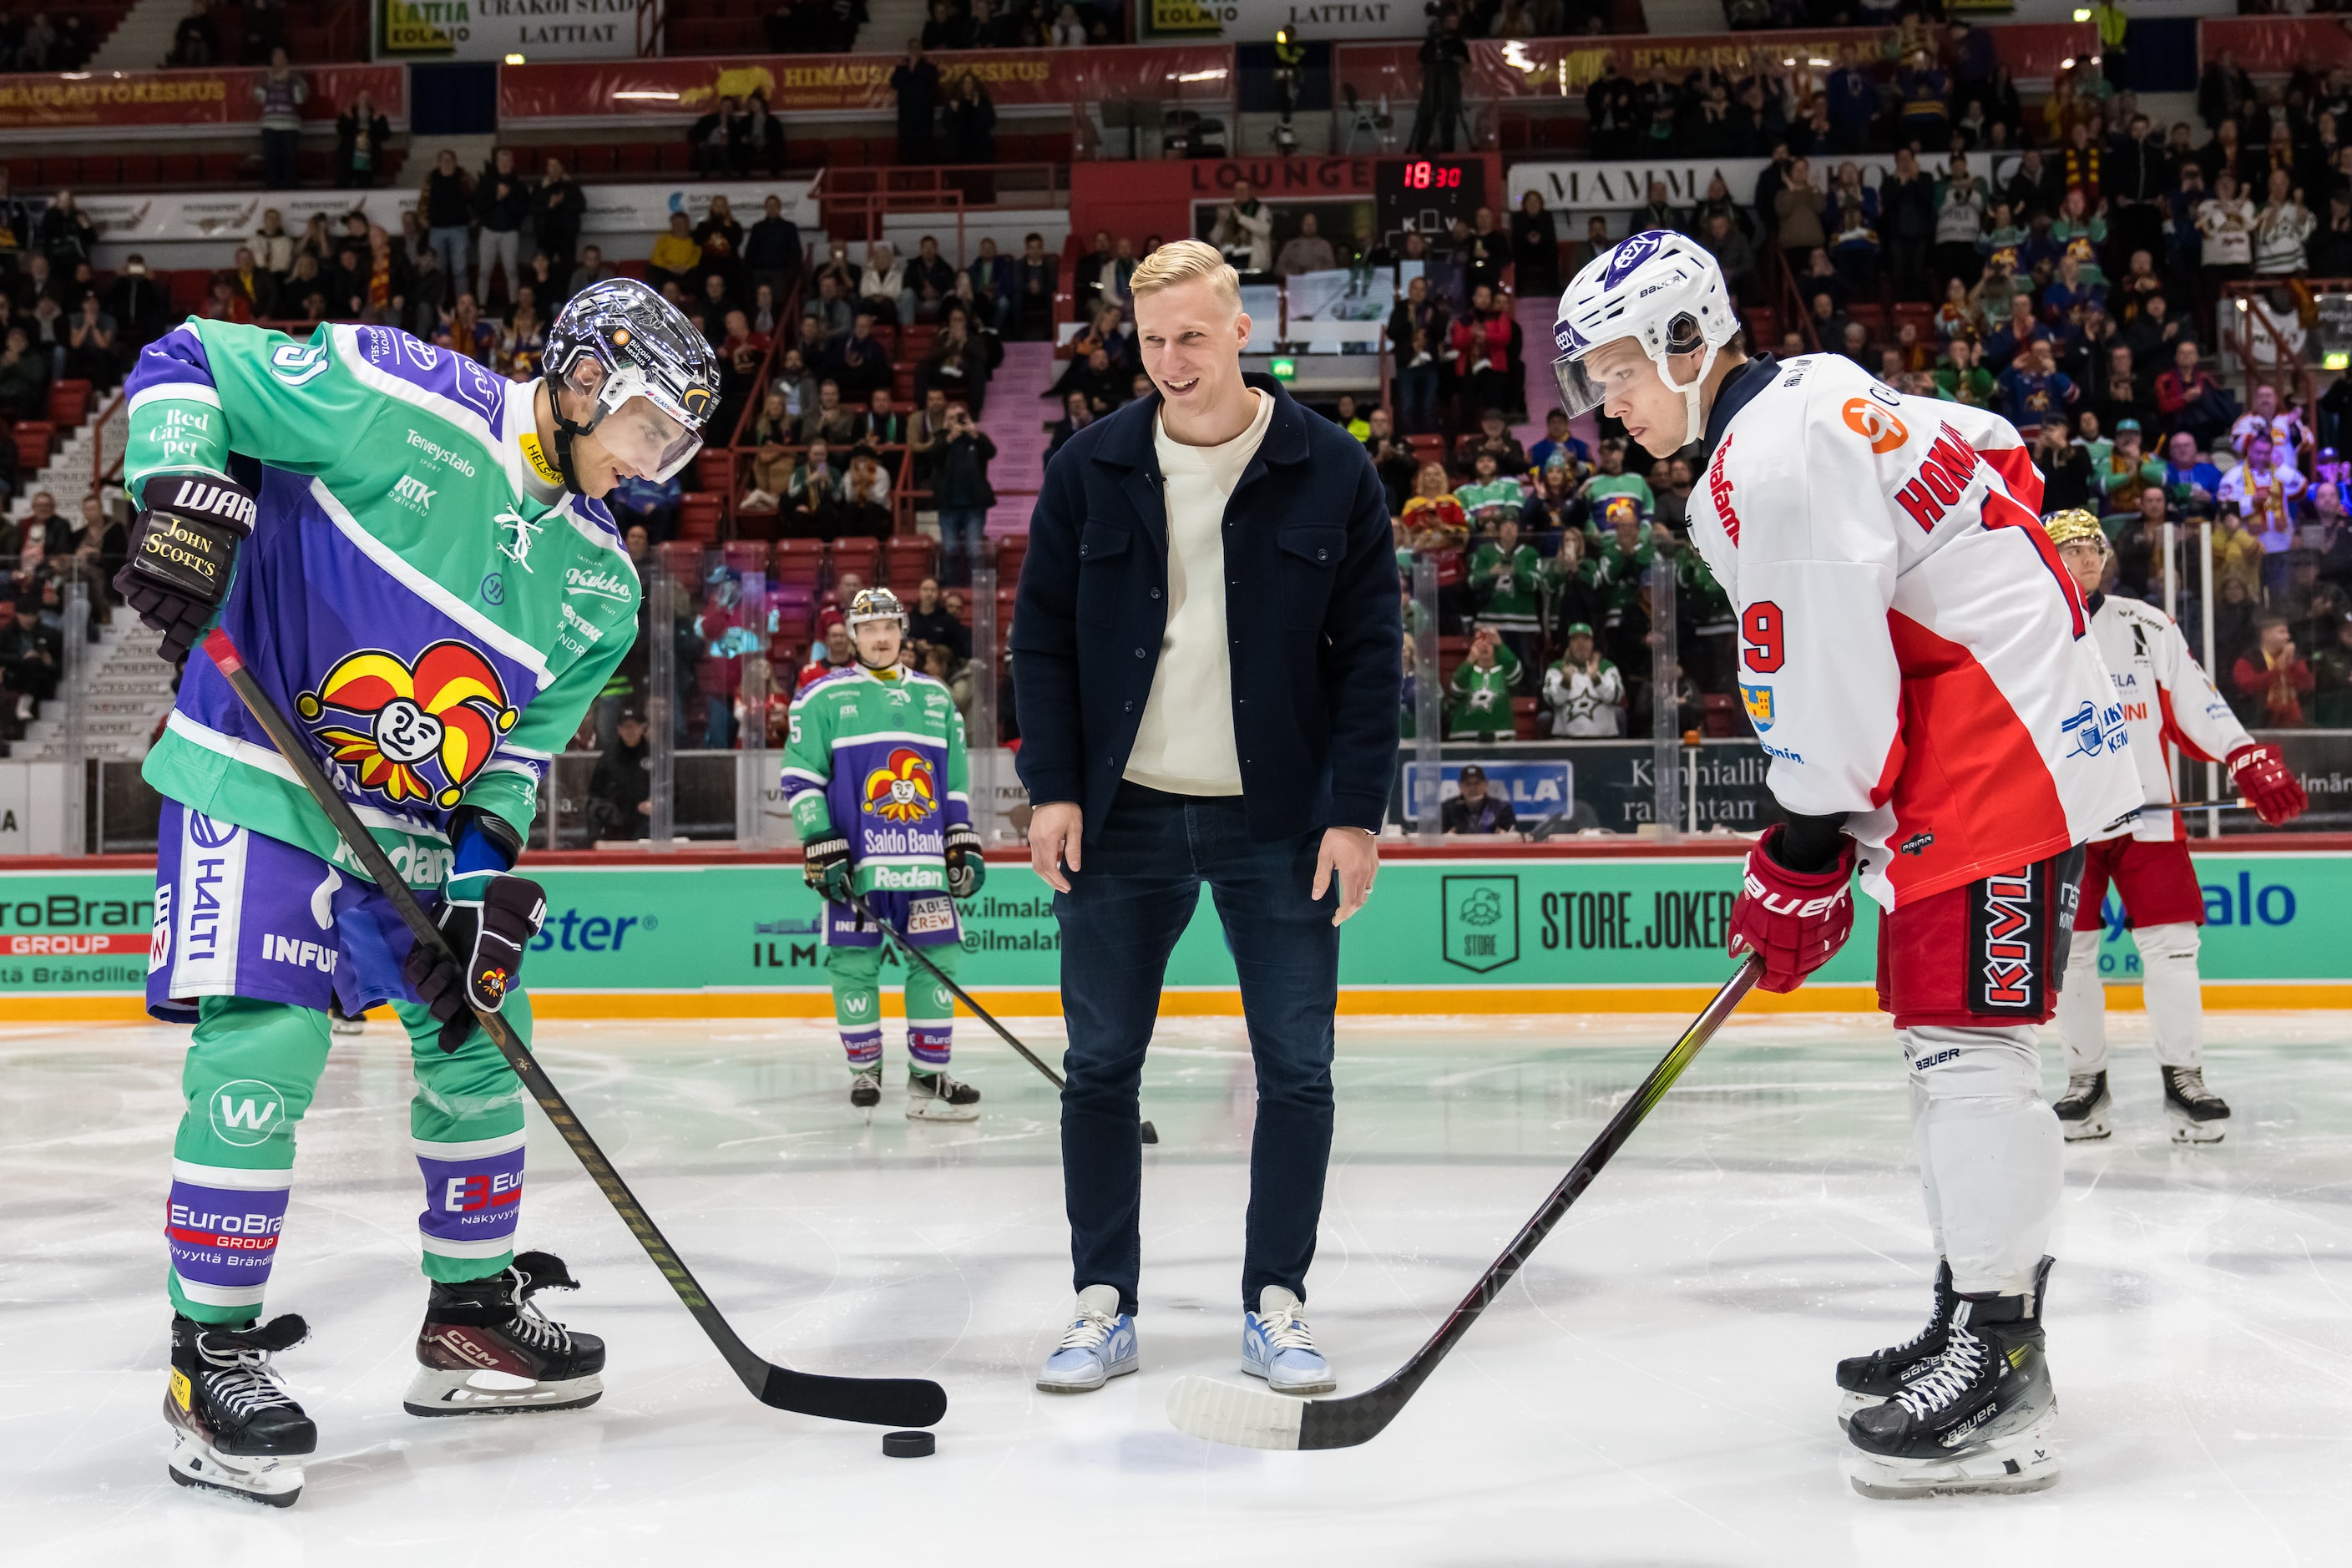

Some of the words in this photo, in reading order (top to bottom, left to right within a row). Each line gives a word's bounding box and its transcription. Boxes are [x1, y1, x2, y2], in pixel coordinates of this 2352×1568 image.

[1289, 3, 1390, 23] LATTIAT
[520, 25, 618, 43] LATTIAT
[1192, 161, 1369, 190] LOUNGE
[1614, 234, 1660, 270] eezy
[624, 344, 647, 367] keskus
[628, 338, 652, 362] Bitcoin
[653, 396, 682, 419] GLASSDRIVE
[166, 408, 210, 432] Red
[163, 439, 200, 459] pet
[406, 428, 476, 478] Terveystalo
[419, 458, 442, 474] SPORT
[393, 473, 438, 510] RTK
[163, 517, 213, 554] JOHN
[145, 533, 216, 577] SCOTT'S
[565, 568, 632, 598] Kukko
[601, 603, 616, 616] OLUT
[864, 827, 905, 854] Saldo
[908, 827, 944, 854] Bank
[1902, 834, 1933, 852] PRIMA
[874, 865, 943, 888] Redan
[188, 858, 225, 961] HALTI
[908, 913, 951, 933] CREW
[10, 935, 110, 954] GROUP
[1463, 934, 1497, 956] STORE
[845, 996, 867, 1014] W
[1915, 1048, 1960, 1071] BAUER
[220, 1095, 278, 1130] W
[216, 1236, 274, 1250] GROUP
[447, 1329, 500, 1367] CCM
[1946, 1402, 1998, 1442] BAUER
